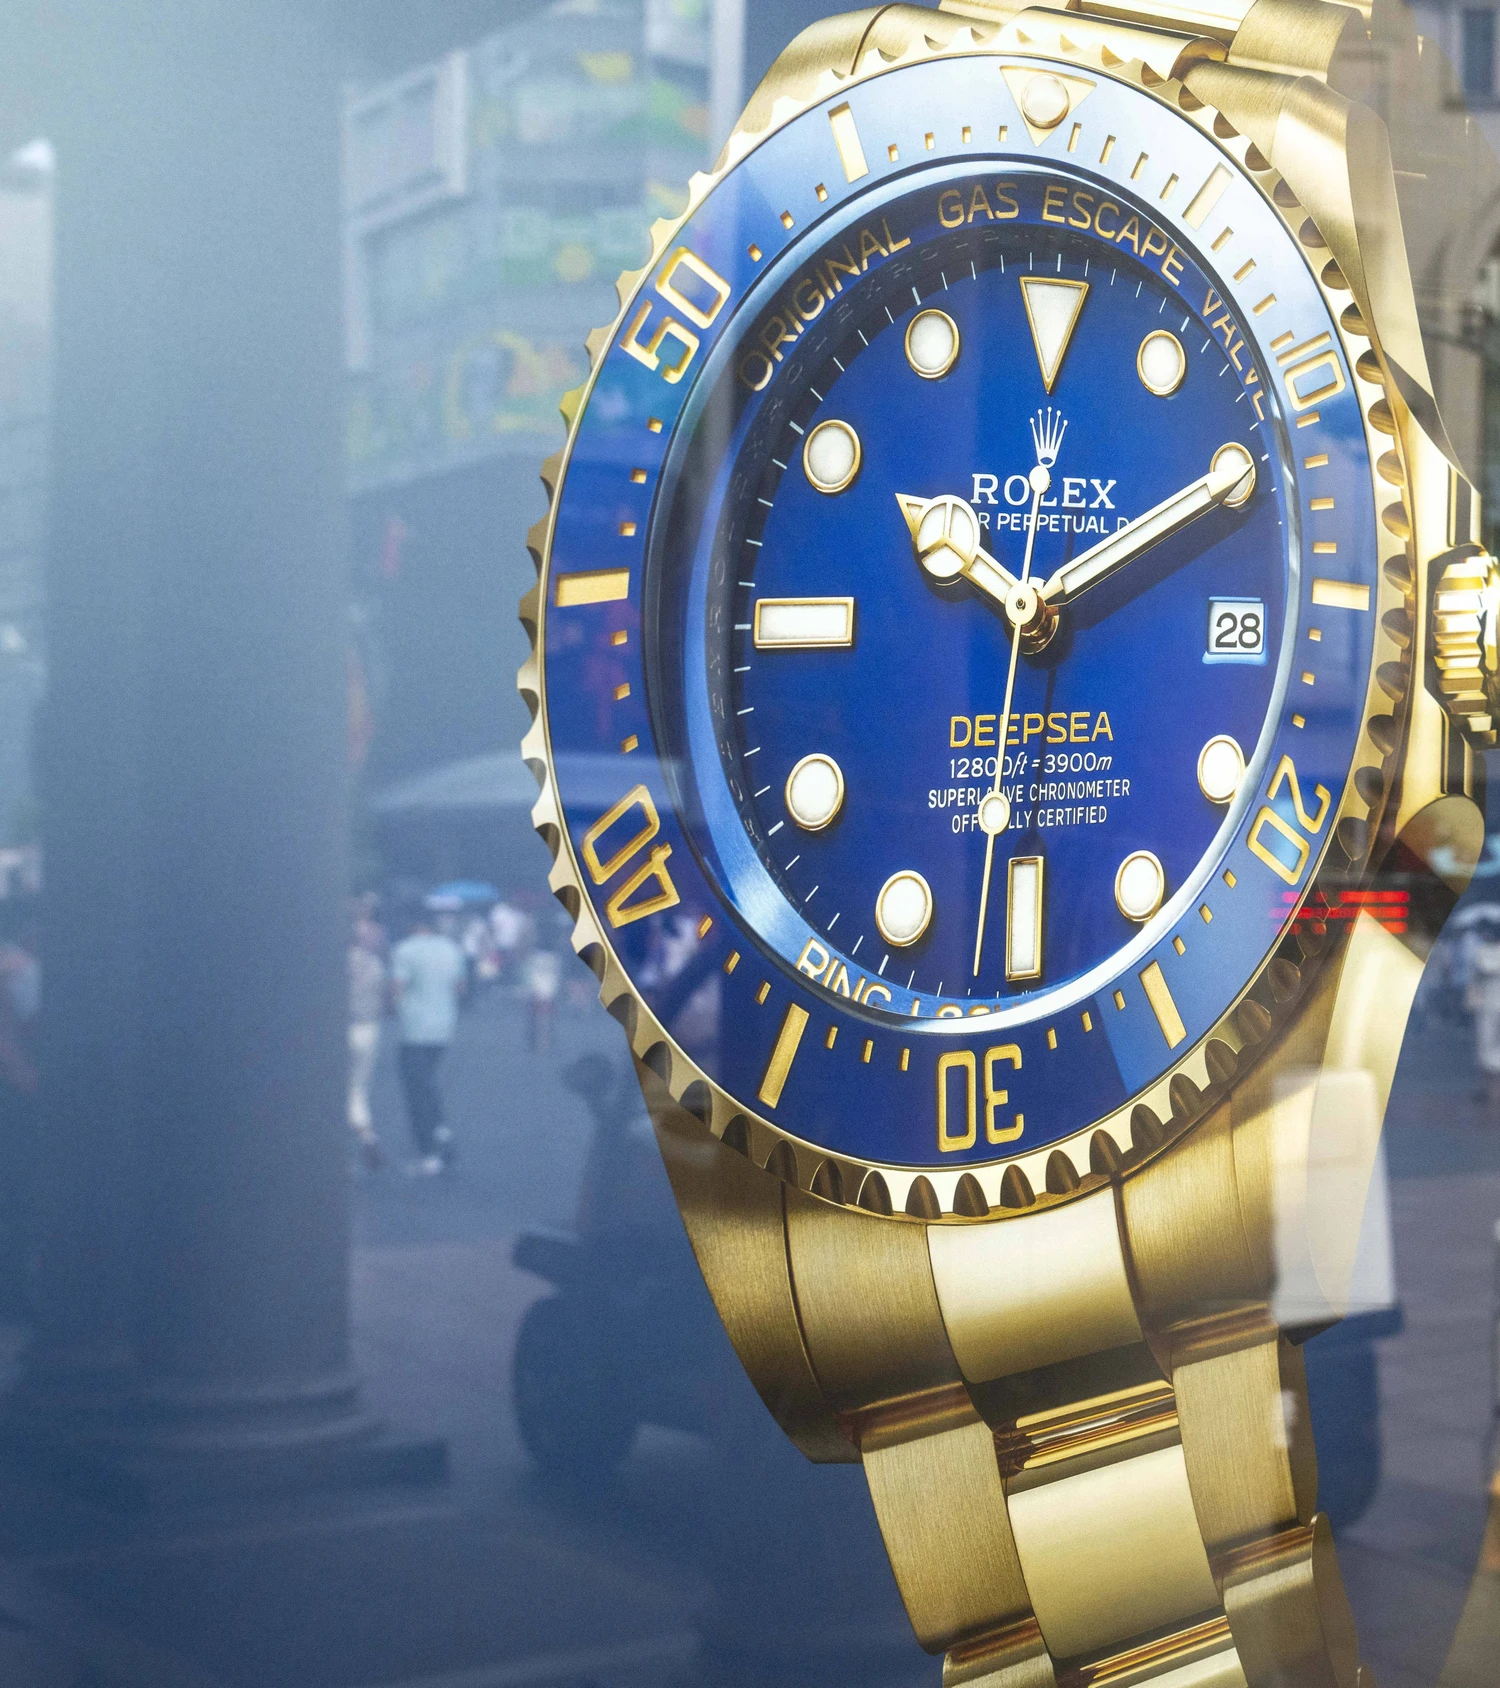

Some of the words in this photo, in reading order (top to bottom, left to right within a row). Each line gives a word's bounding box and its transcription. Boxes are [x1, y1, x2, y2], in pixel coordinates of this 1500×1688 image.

[619, 246, 732, 385] 50
[737, 217, 912, 392] ORIGINAL
[937, 182, 1020, 229] GAS
[1041, 184, 1190, 287] ESCAPE
[1275, 330, 1347, 412] 10
[1215, 612, 1261, 649] 28
[950, 711, 1114, 748] DEEPSEA
[1044, 752, 1113, 774] 3900m
[928, 784, 1025, 809] SUPERLVE
[1029, 778, 1131, 802] CHRONOMETER
[951, 810, 1033, 834] OFFLLY
[1037, 805, 1107, 827] CERTIFIED
[1246, 753, 1332, 886] 20
[580, 783, 681, 930] 40
[937, 1043, 1025, 1153] 30
